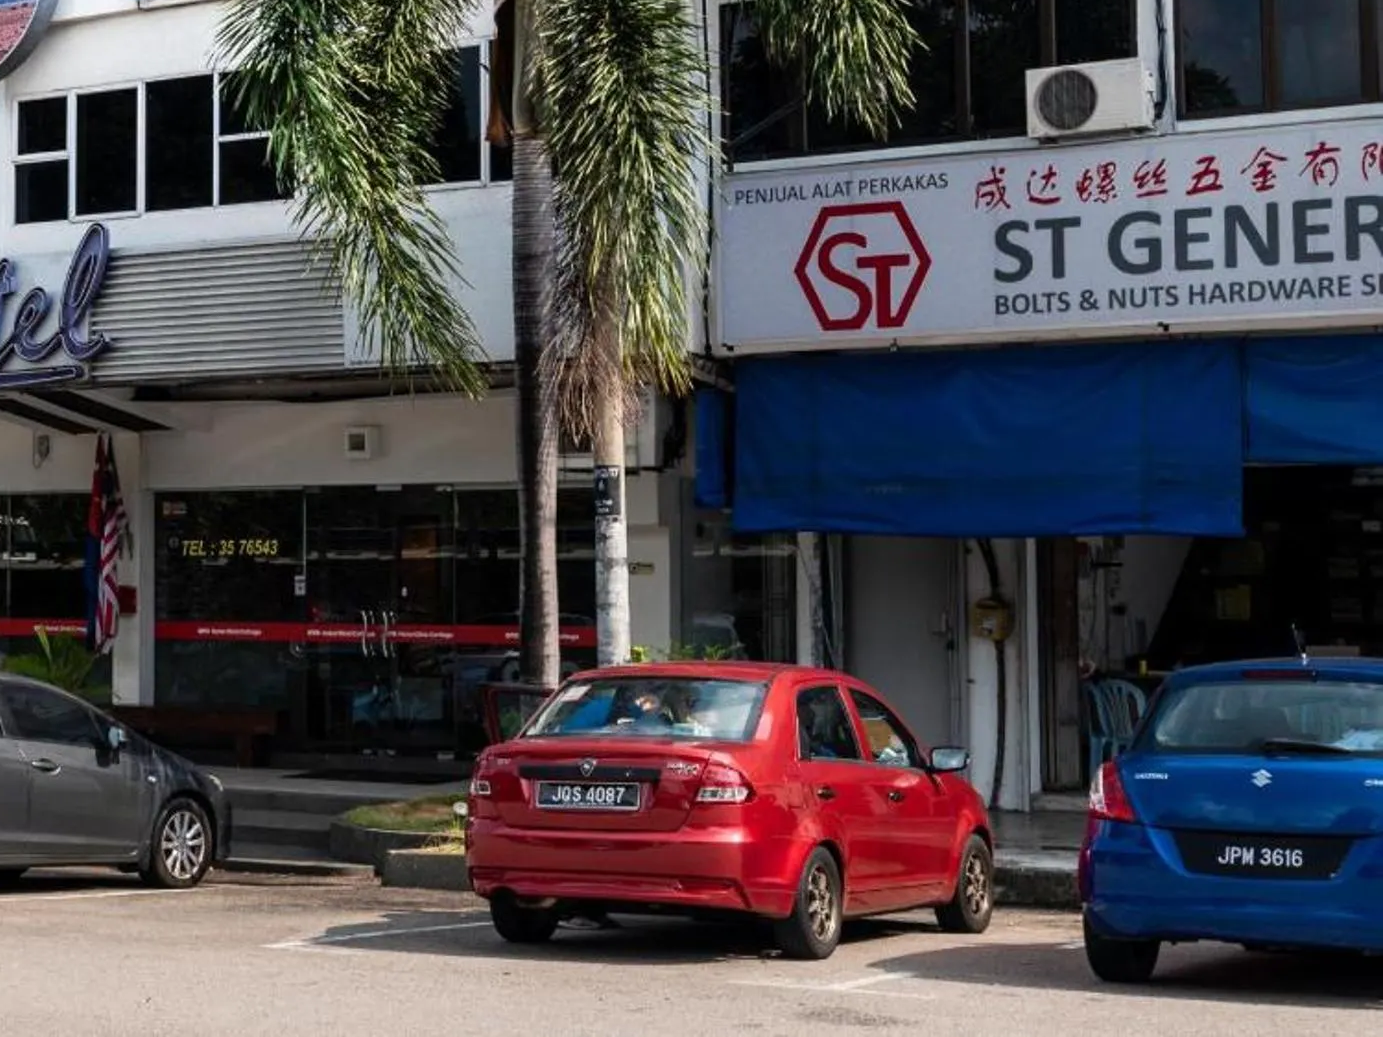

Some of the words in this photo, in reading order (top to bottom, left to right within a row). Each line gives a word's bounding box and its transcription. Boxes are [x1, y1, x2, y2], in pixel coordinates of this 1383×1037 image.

[734, 186, 807, 205] PENJUAL
[812, 180, 853, 200] ALAT
[858, 172, 949, 196] PERKAKAS
[994, 216, 1082, 283] ST
[818, 232, 910, 329] ST
[995, 290, 1071, 316] BOLTS
[1079, 288, 1099, 312] &
[1109, 285, 1179, 310] NUTS
[1189, 274, 1352, 306] HARDWARE
[181, 539, 207, 557] TEL
[585, 787, 626, 804] 4087
[1217, 846, 1255, 866] JPM
[1260, 847, 1304, 867] 3616
